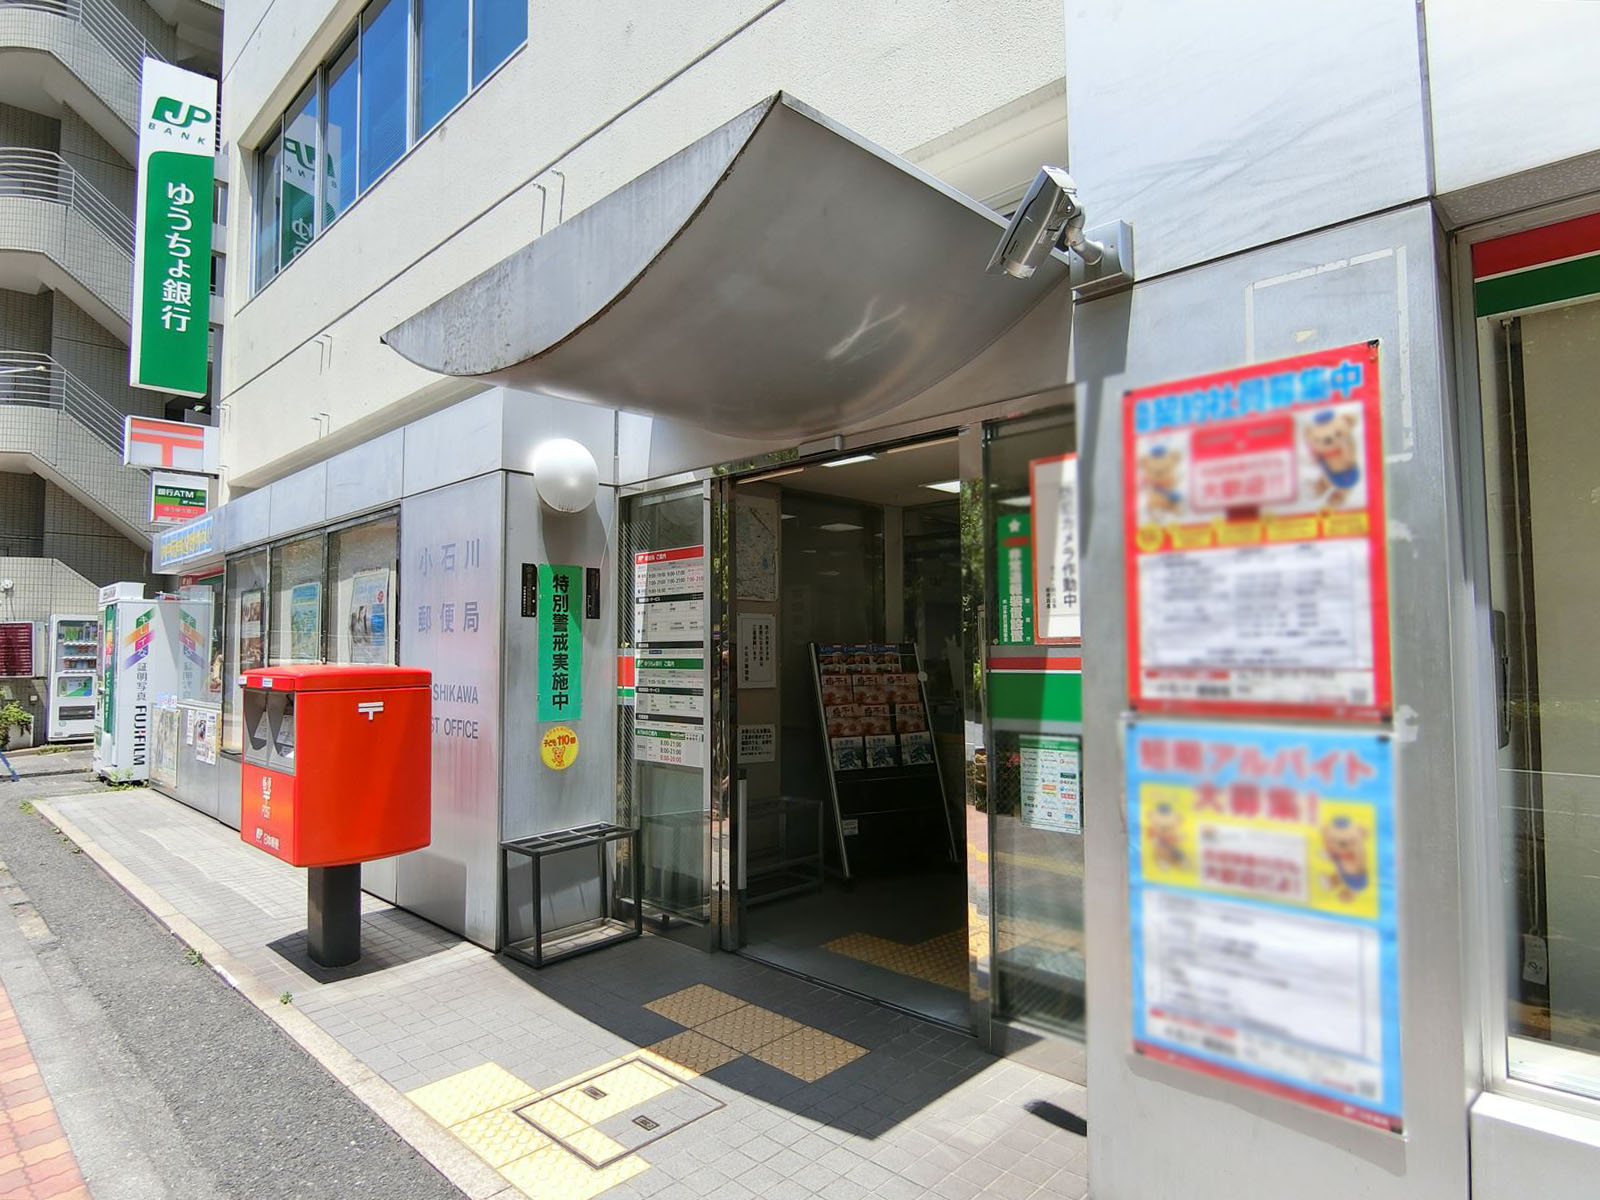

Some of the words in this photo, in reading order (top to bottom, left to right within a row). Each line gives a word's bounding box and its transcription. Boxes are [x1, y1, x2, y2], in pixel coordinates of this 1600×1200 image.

[151, 96, 212, 128] JP
[148, 123, 206, 145] BANK
[161, 182, 195, 333] ゆうちょ銀行
[418, 538, 480, 576] 小石川
[418, 601, 480, 634] 郵便局
[552, 573, 569, 711] 特別警戒実施中
[136, 662, 148, 701] 証明写真
[133, 705, 148, 766] FUJIFILM
[444, 718, 479, 739] OFFICE
